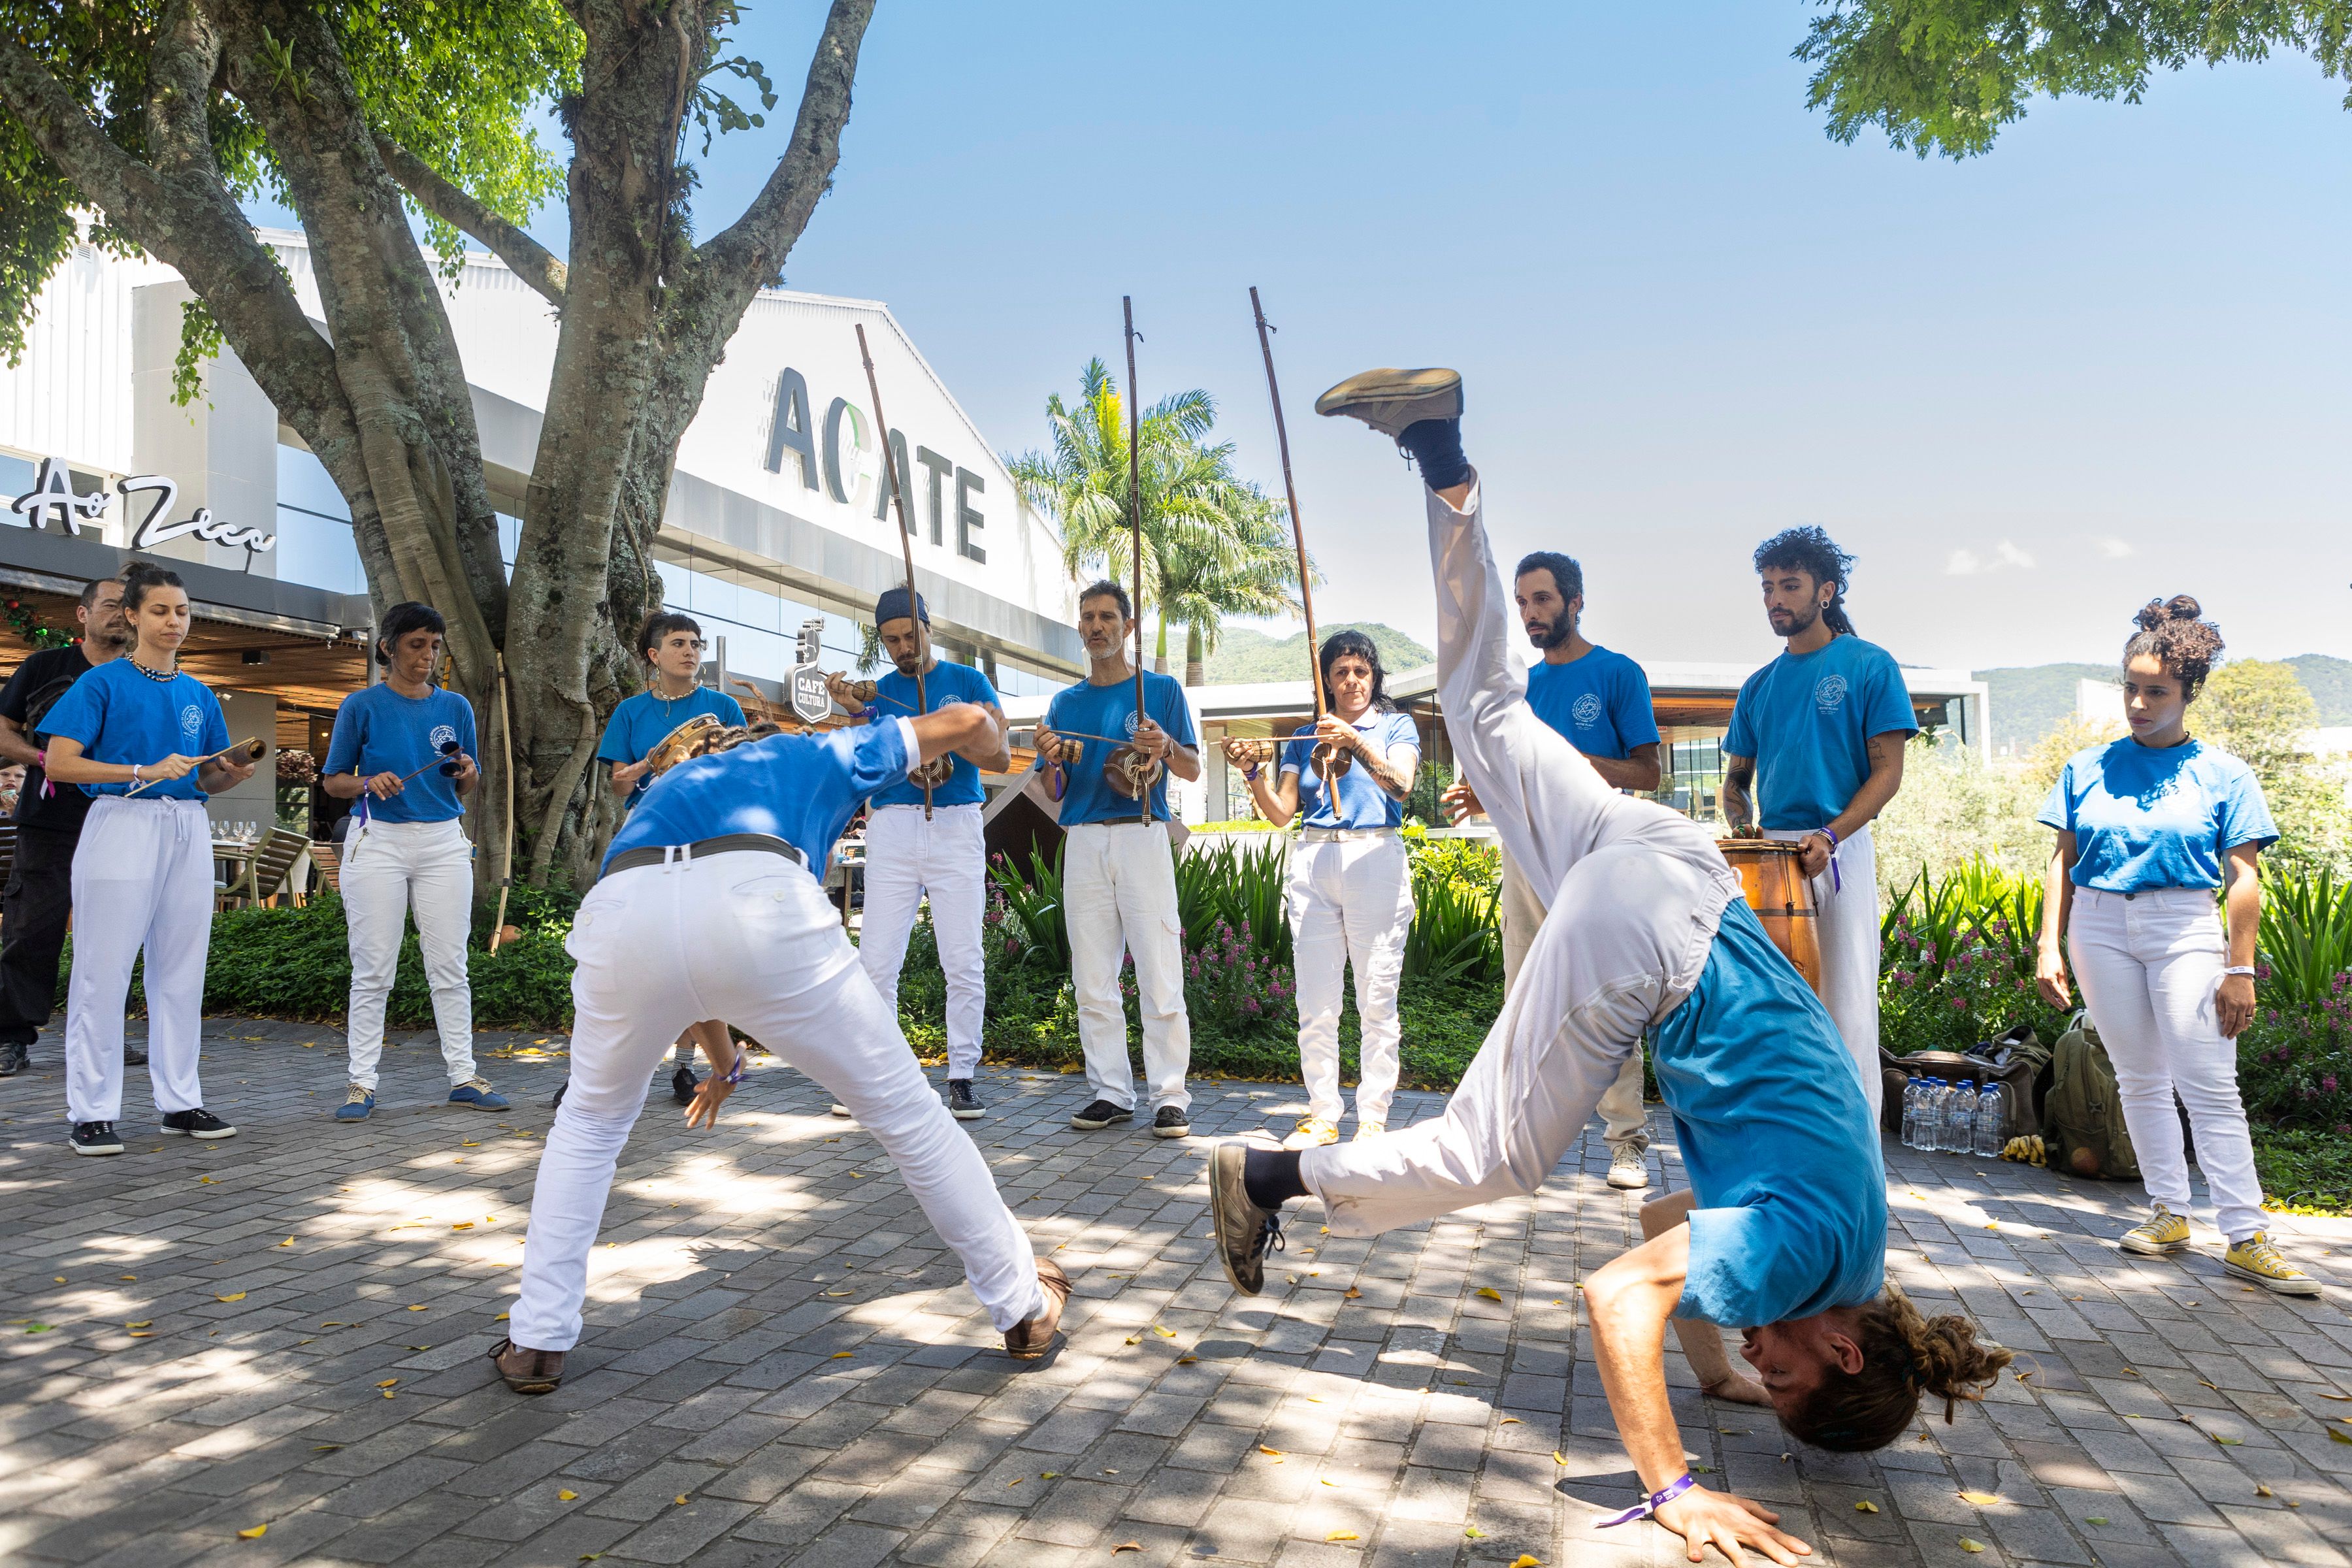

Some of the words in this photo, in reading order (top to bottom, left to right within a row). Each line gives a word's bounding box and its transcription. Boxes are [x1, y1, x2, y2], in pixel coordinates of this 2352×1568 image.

[11, 457, 113, 536] Ao
[764, 367, 986, 565] ACATE
[798, 692, 825, 708] CULTURA
